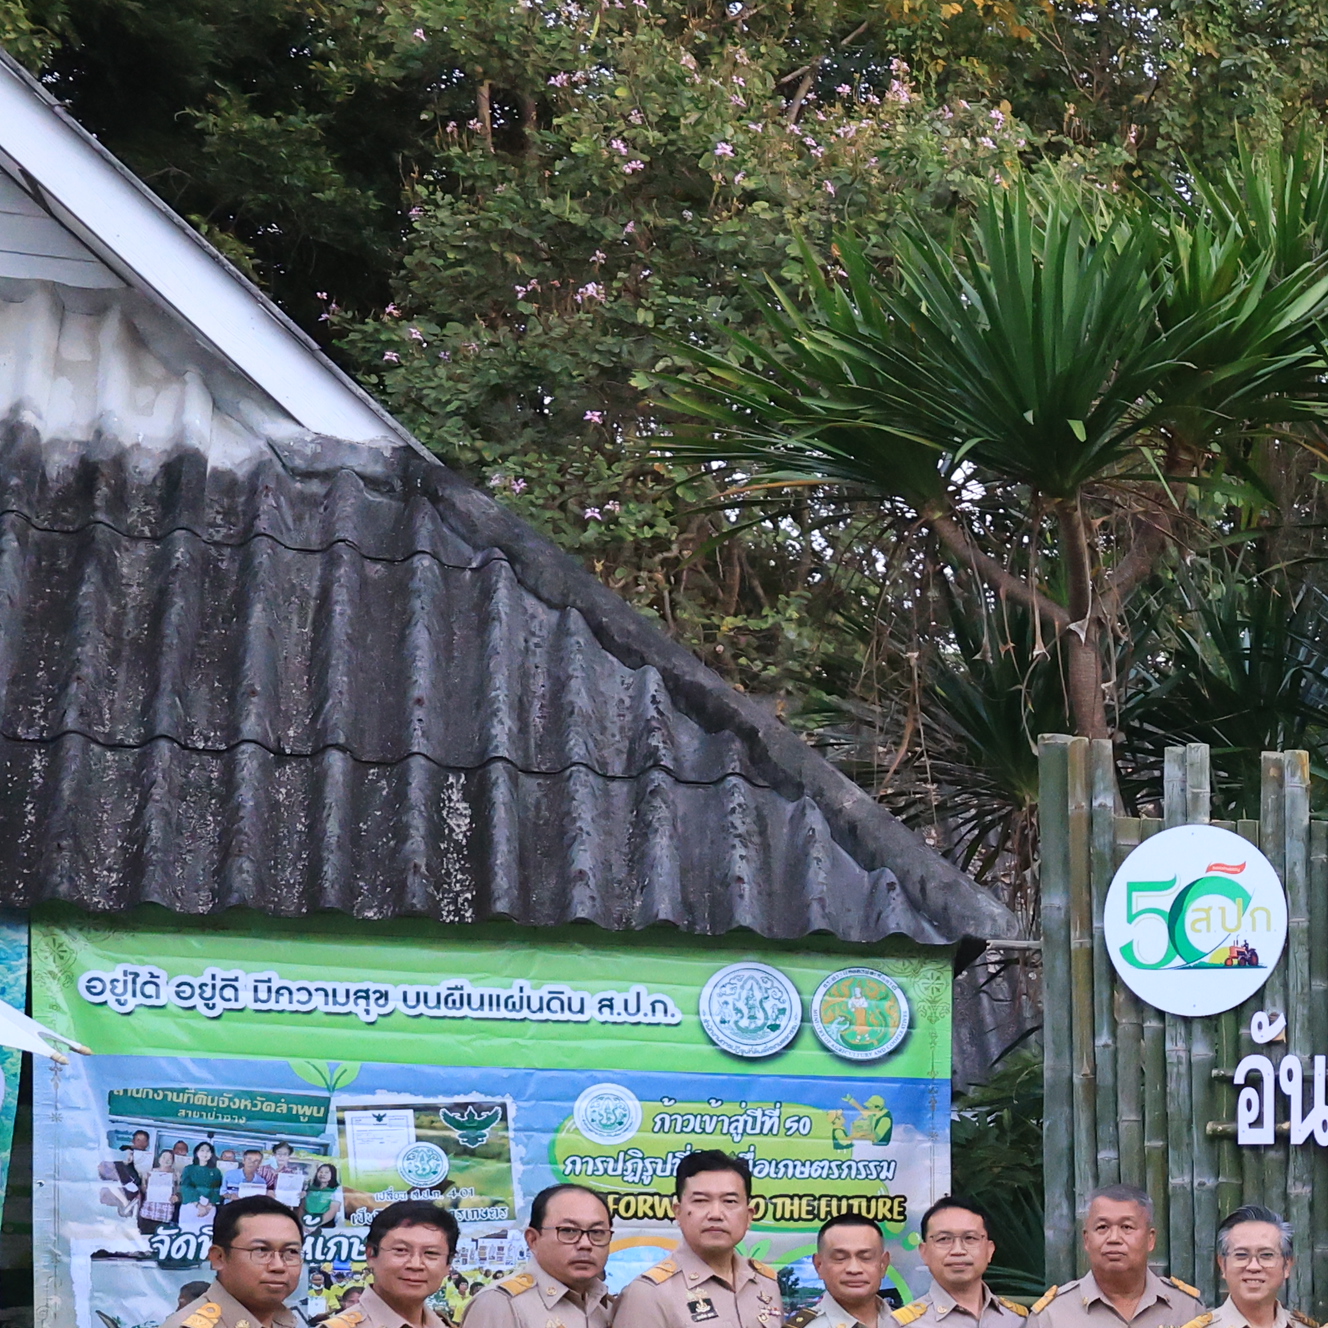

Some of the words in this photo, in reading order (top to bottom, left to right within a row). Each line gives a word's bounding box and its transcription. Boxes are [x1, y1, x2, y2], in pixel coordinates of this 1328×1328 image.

[85, 970, 161, 1006] อยู่ได้
[174, 973, 240, 1010] อยู่ดี
[252, 976, 390, 1016] มีความสุข
[401, 985, 586, 1016] บนผืนแผ่นดิน
[596, 991, 677, 1018] ส.ป.ก.
[652, 1096, 780, 1142] ก้าวเข้าสู่ปีที่
[784, 1115, 812, 1137] 50
[606, 1194, 680, 1219] FORW
[771, 1196, 814, 1219] THE
[819, 1196, 906, 1220] FUTURE
